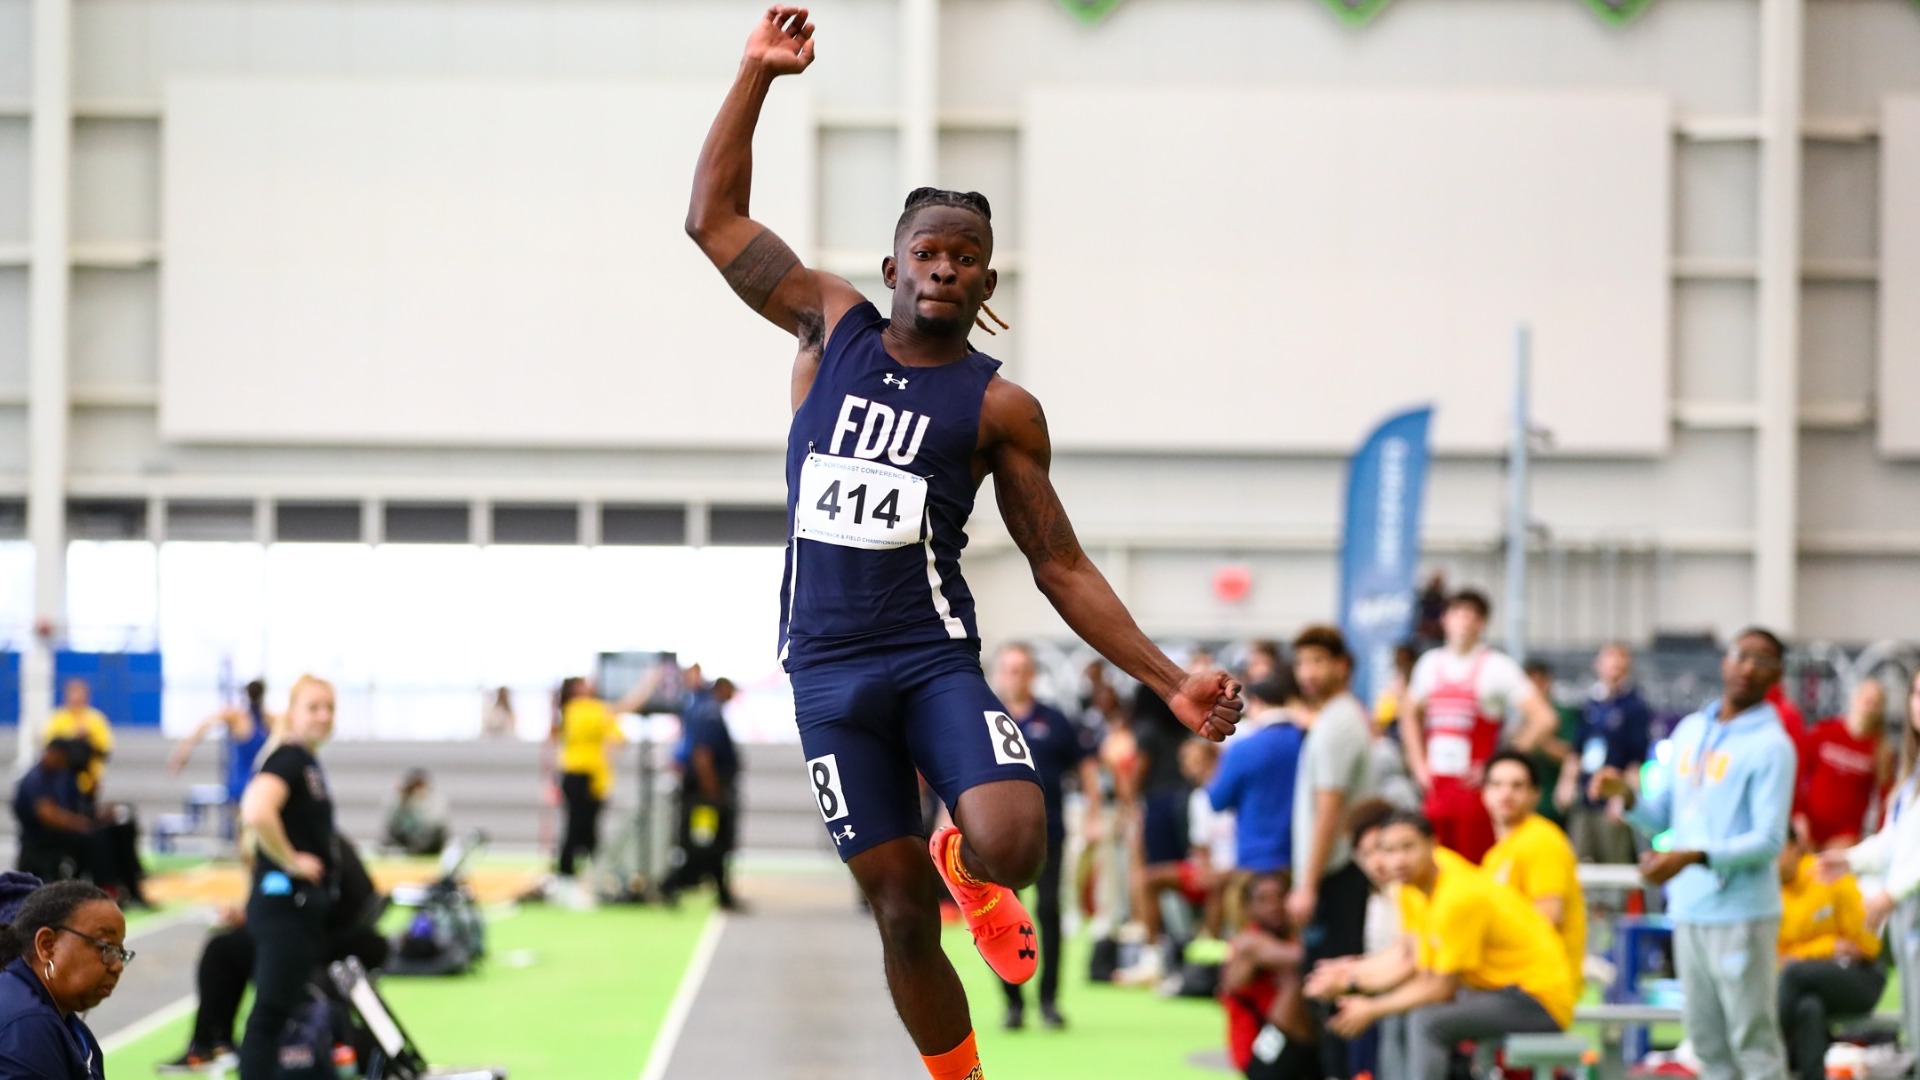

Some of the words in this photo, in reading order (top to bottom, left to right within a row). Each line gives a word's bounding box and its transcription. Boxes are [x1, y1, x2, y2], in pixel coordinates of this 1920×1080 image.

[829, 394, 931, 466] FDU
[823, 461, 859, 472] NORTHEAST
[860, 466, 907, 480] CONFERENCE
[816, 479, 901, 530] 414
[845, 534, 861, 542] FIELD
[994, 714, 1026, 760] 8
[812, 761, 839, 819] 8
